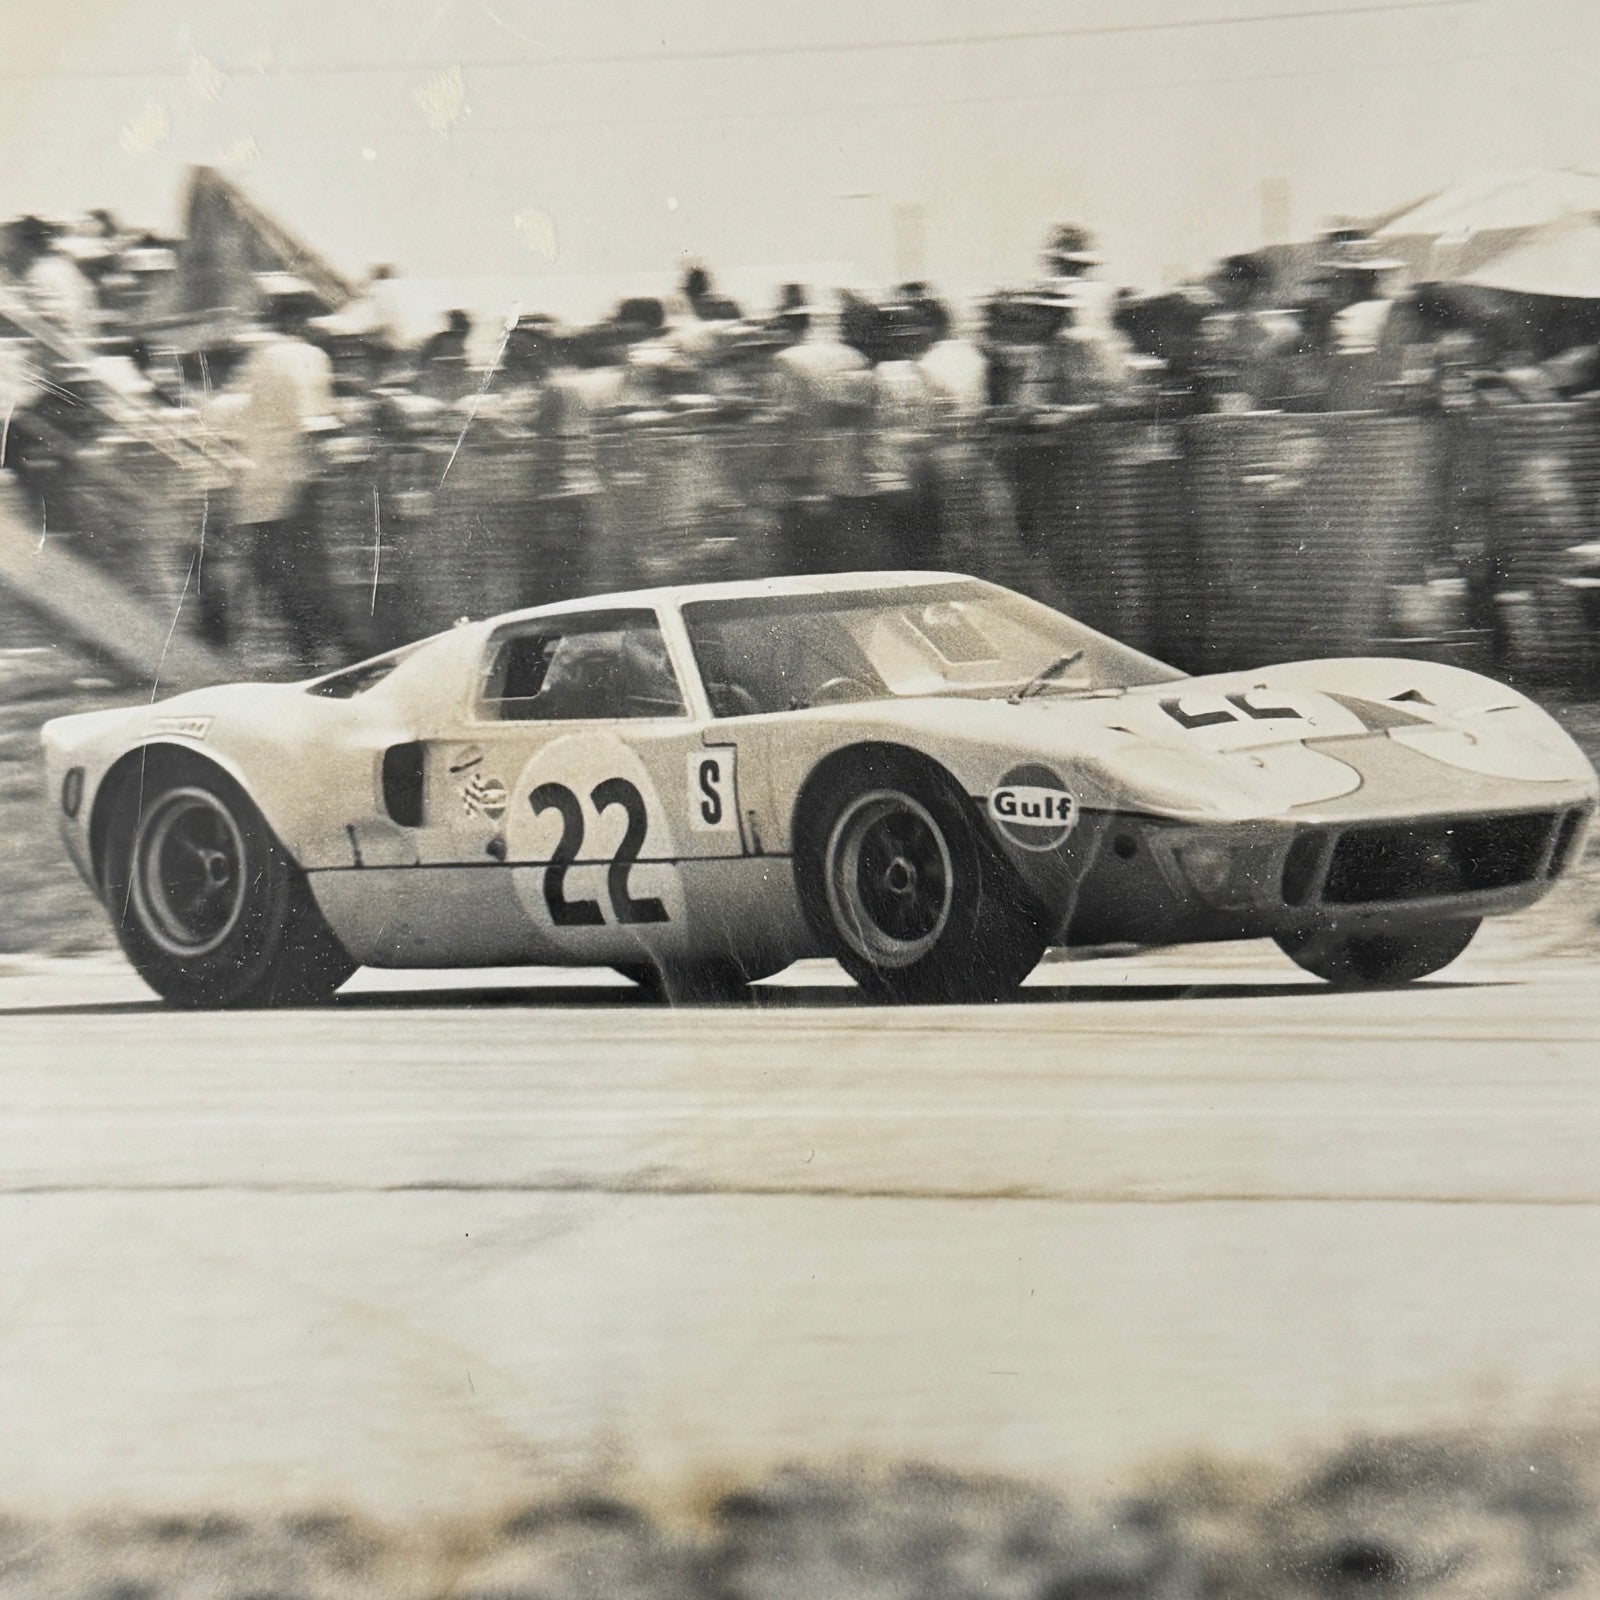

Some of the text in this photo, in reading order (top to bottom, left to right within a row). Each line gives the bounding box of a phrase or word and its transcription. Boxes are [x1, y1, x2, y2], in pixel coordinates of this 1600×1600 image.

[699, 759, 722, 825] S
[994, 791, 1071, 820] Gulf
[528, 777, 670, 926] 22
